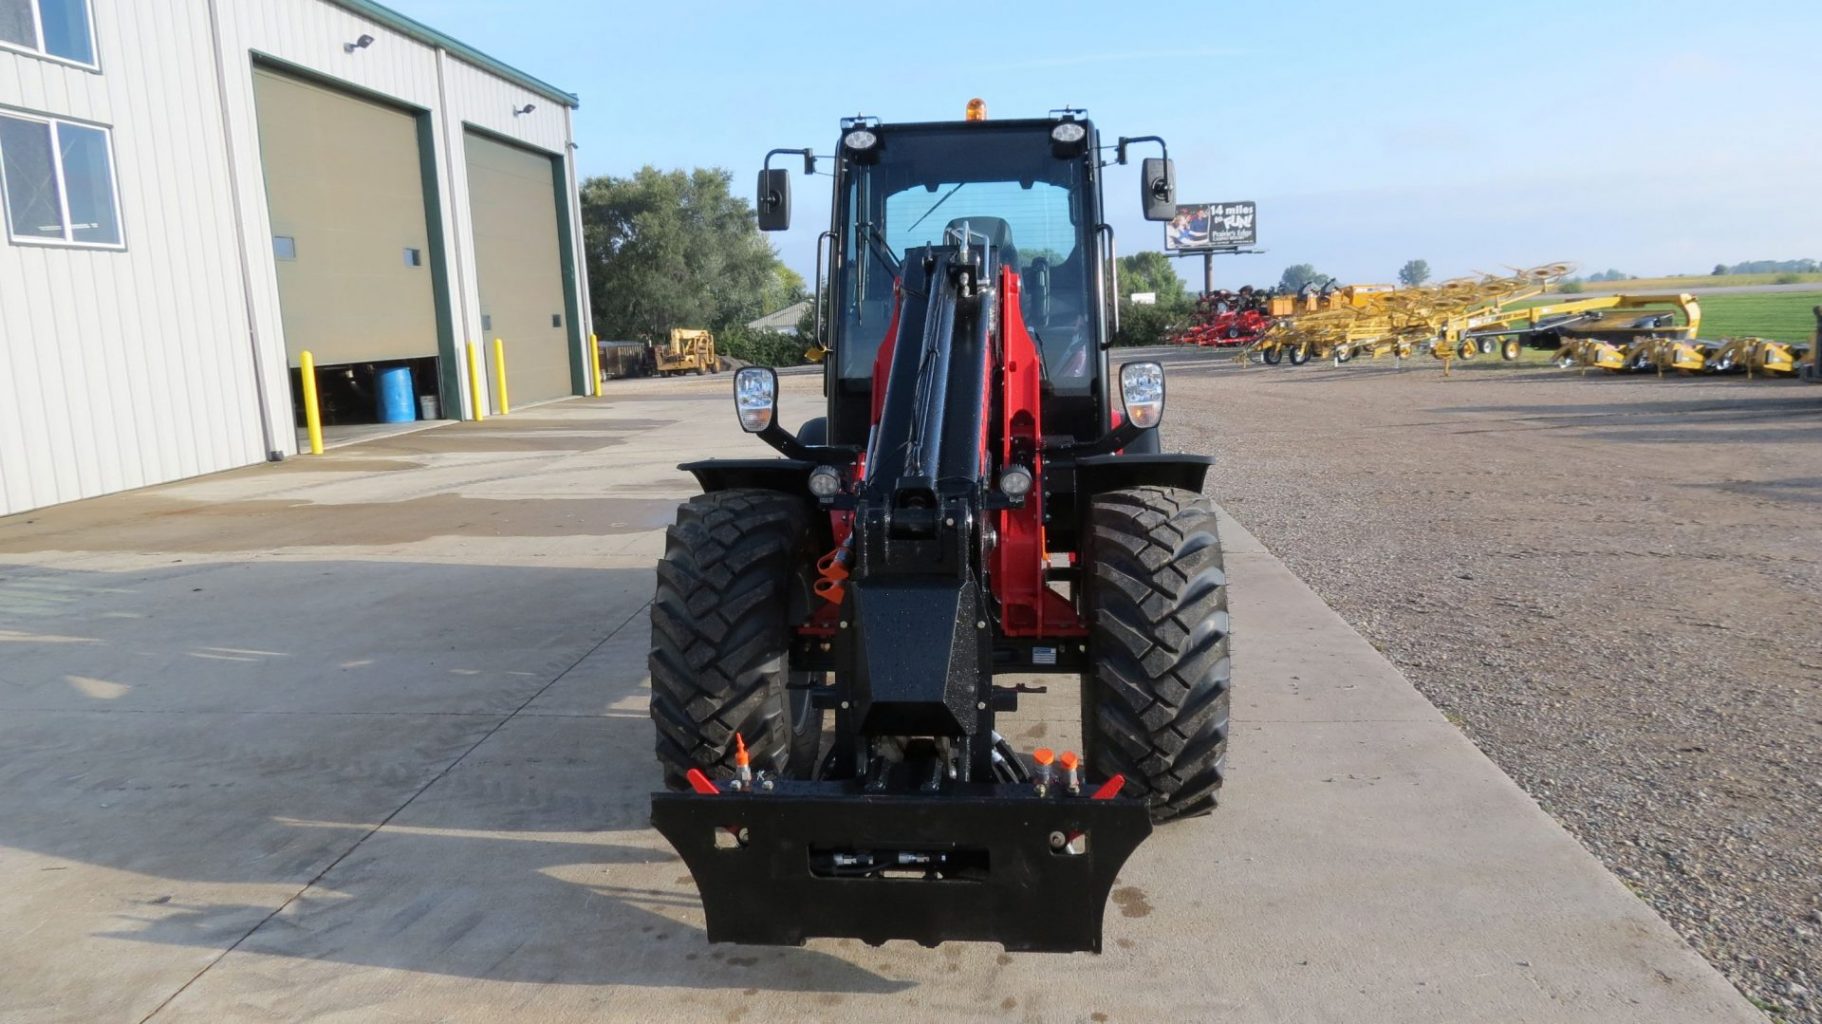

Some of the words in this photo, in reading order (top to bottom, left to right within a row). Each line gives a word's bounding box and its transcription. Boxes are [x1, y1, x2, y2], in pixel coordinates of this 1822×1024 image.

[1211, 204, 1223, 215] 14
[1226, 204, 1253, 215] miles
[1223, 214, 1253, 229] FUN!
